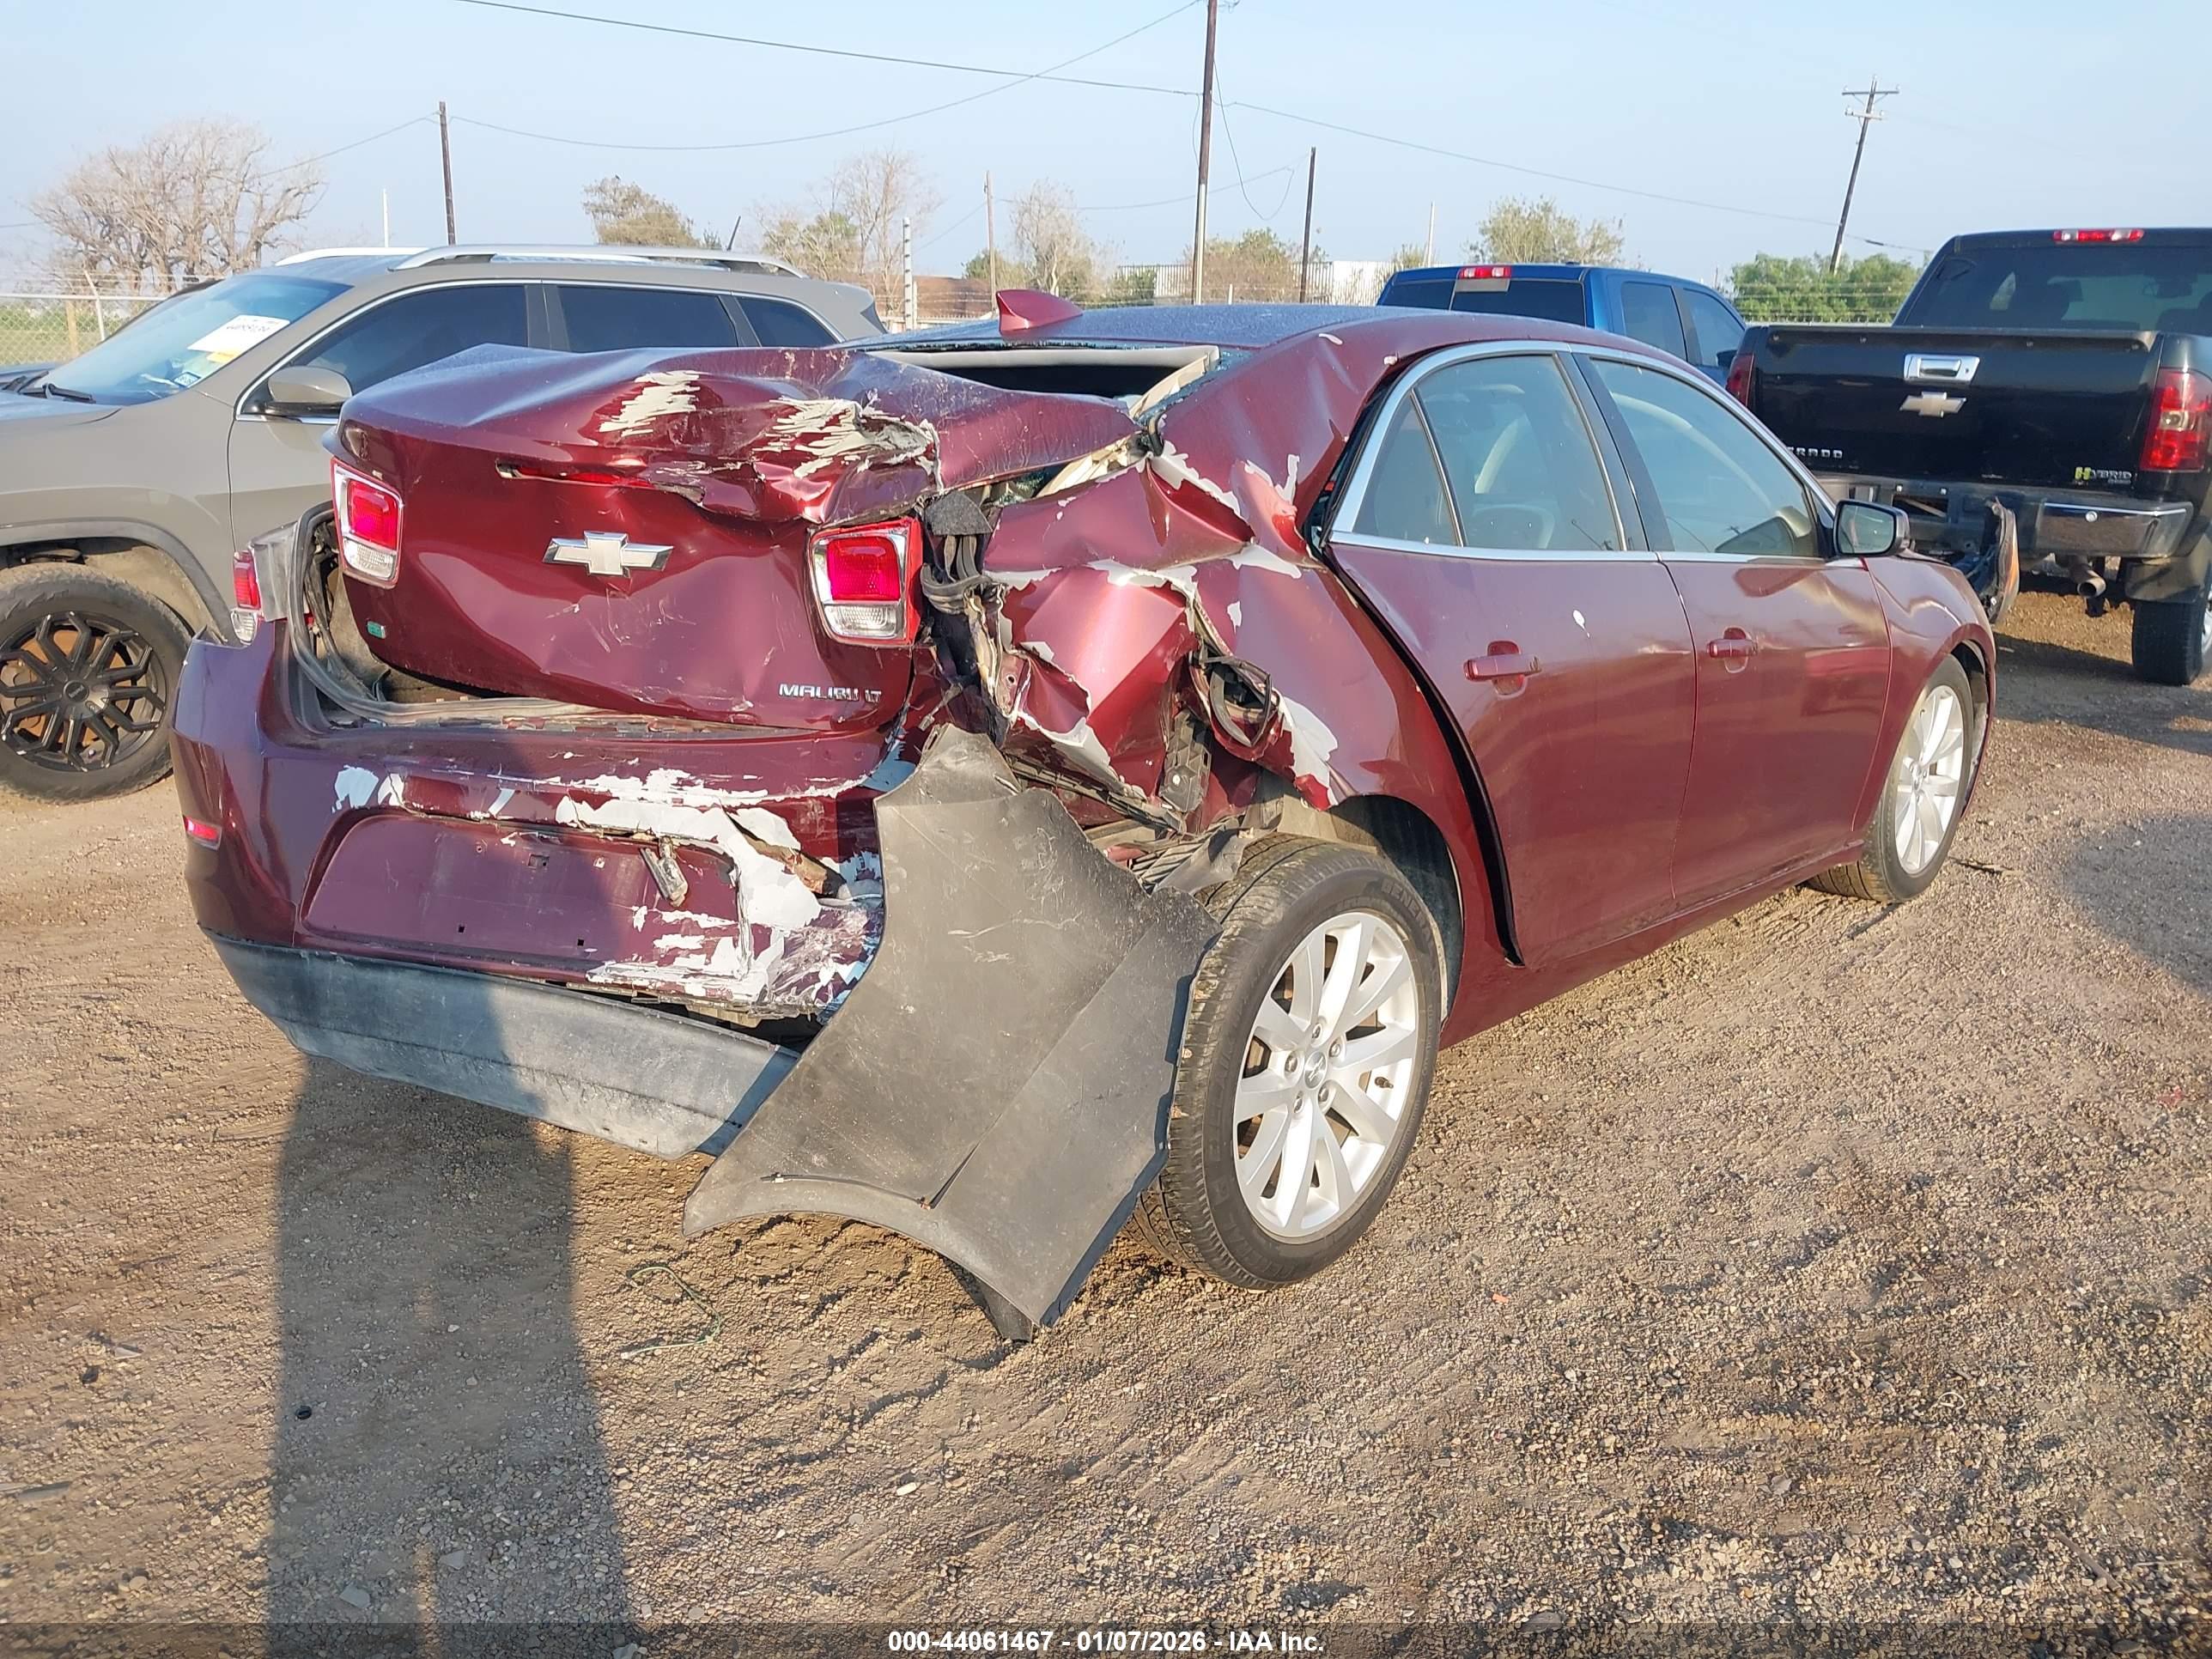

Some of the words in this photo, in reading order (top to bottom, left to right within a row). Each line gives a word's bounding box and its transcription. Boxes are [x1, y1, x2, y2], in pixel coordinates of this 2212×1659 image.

[2075, 466, 2132, 480] HYBRID
[779, 684, 860, 701] MALIBU
[865, 690, 882, 703] LT
